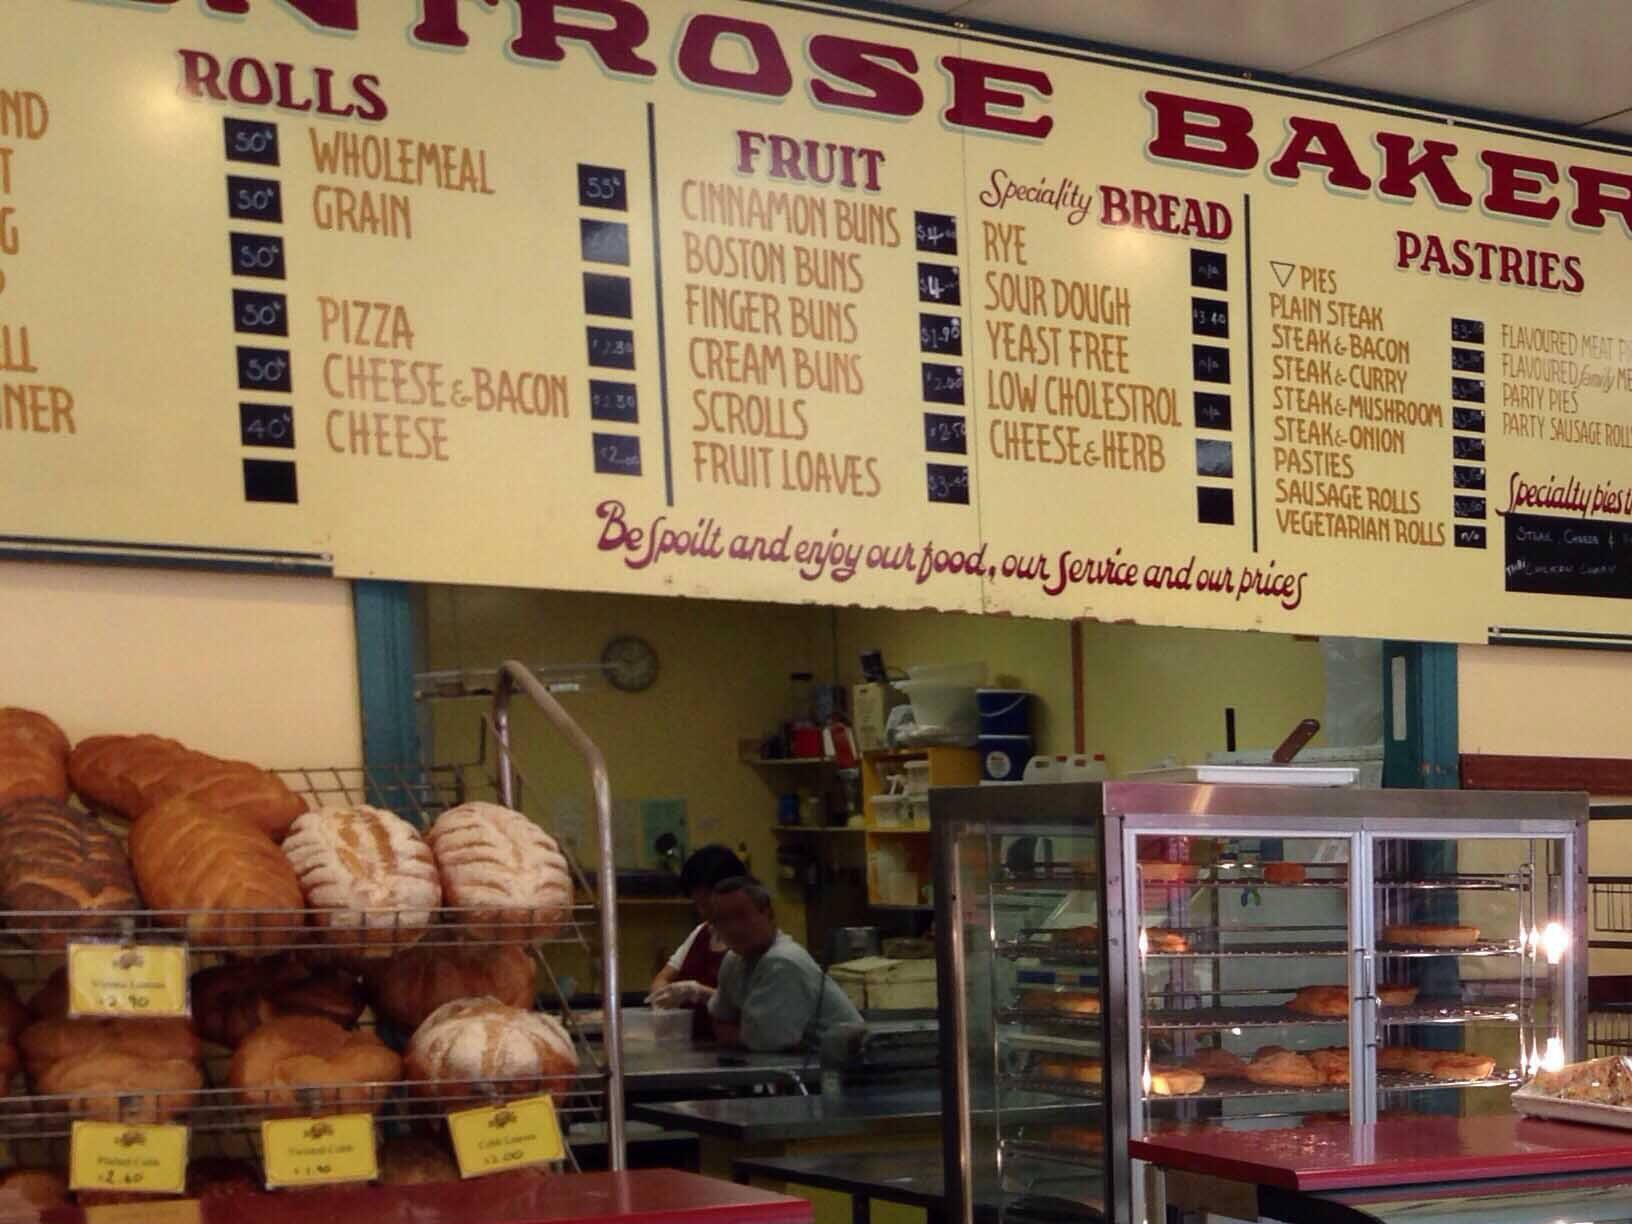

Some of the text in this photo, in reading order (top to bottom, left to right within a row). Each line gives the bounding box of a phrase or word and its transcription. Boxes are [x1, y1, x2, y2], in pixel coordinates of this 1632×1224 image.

[178, 49, 388, 121] ROLLS
[309, 127, 496, 195] WHOLEMEAL
[736, 129, 887, 192] FRUIT
[313, 184, 413, 240] GRAIN
[681, 178, 829, 238] CINNAMON
[833, 199, 900, 249] BUNS
[1098, 184, 1234, 241] BREAD
[682, 230, 786, 284] BOSTON
[793, 245, 864, 294] BUNS
[982, 220, 1028, 266] RYE
[1396, 229, 1585, 293] PASTRIES
[985, 270, 1047, 320] SOUR
[1050, 278, 1131, 327] DOUGH
[1300, 265, 1337, 295] PIES
[317, 296, 414, 350] PIZZA
[685, 283, 858, 344] FINGER BUNS
[1269, 291, 1384, 332] PLAIN STEAK
[985, 319, 1130, 374] YEAST FREE
[1271, 323, 1331, 355] STEAK
[1348, 332, 1411, 365] BACON
[1501, 323, 1578, 356] FLAVOURED
[323, 352, 570, 419] CHEESE & BACON
[688, 337, 864, 396] CREAM BUNS
[1272, 354, 1332, 386] STEAK
[1349, 363, 1408, 396] CURRY
[1502, 352, 1578, 386] FLAVOURED
[0, 384, 76, 434] NER
[692, 389, 809, 441] SCROLLS
[987, 369, 1183, 428] LOW CHOLESTROL
[1273, 385, 1333, 416] STEAK
[1348, 394, 1444, 428] MUSHROOM
[1502, 382, 1579, 414] PARTY PIES
[325, 408, 450, 461] CHEESE
[989, 419, 1081, 467] CHEESE
[1102, 429, 1166, 473] HERB
[1273, 415, 1332, 447] STEAK
[1349, 424, 1405, 455] ONION
[1503, 411, 1546, 439] PARTY
[1550, 417, 1602, 446] SAUSAGE
[692, 441, 882, 499] FRUIT LOAVES
[1273, 446, 1354, 479] PASTIES
[1275, 478, 1421, 515] SAUSAGE ROLLS
[1590, 480, 1623, 517] pies
[1275, 508, 1446, 547] VEGETARIAN ROLLS
[729, 525, 793, 565] and
[795, 528, 864, 583] enjoy
[866, 545, 917, 571] our
[1001, 553, 1051, 581] our
[1143, 556, 1197, 591] and
[1196, 570, 1235, 593] our
